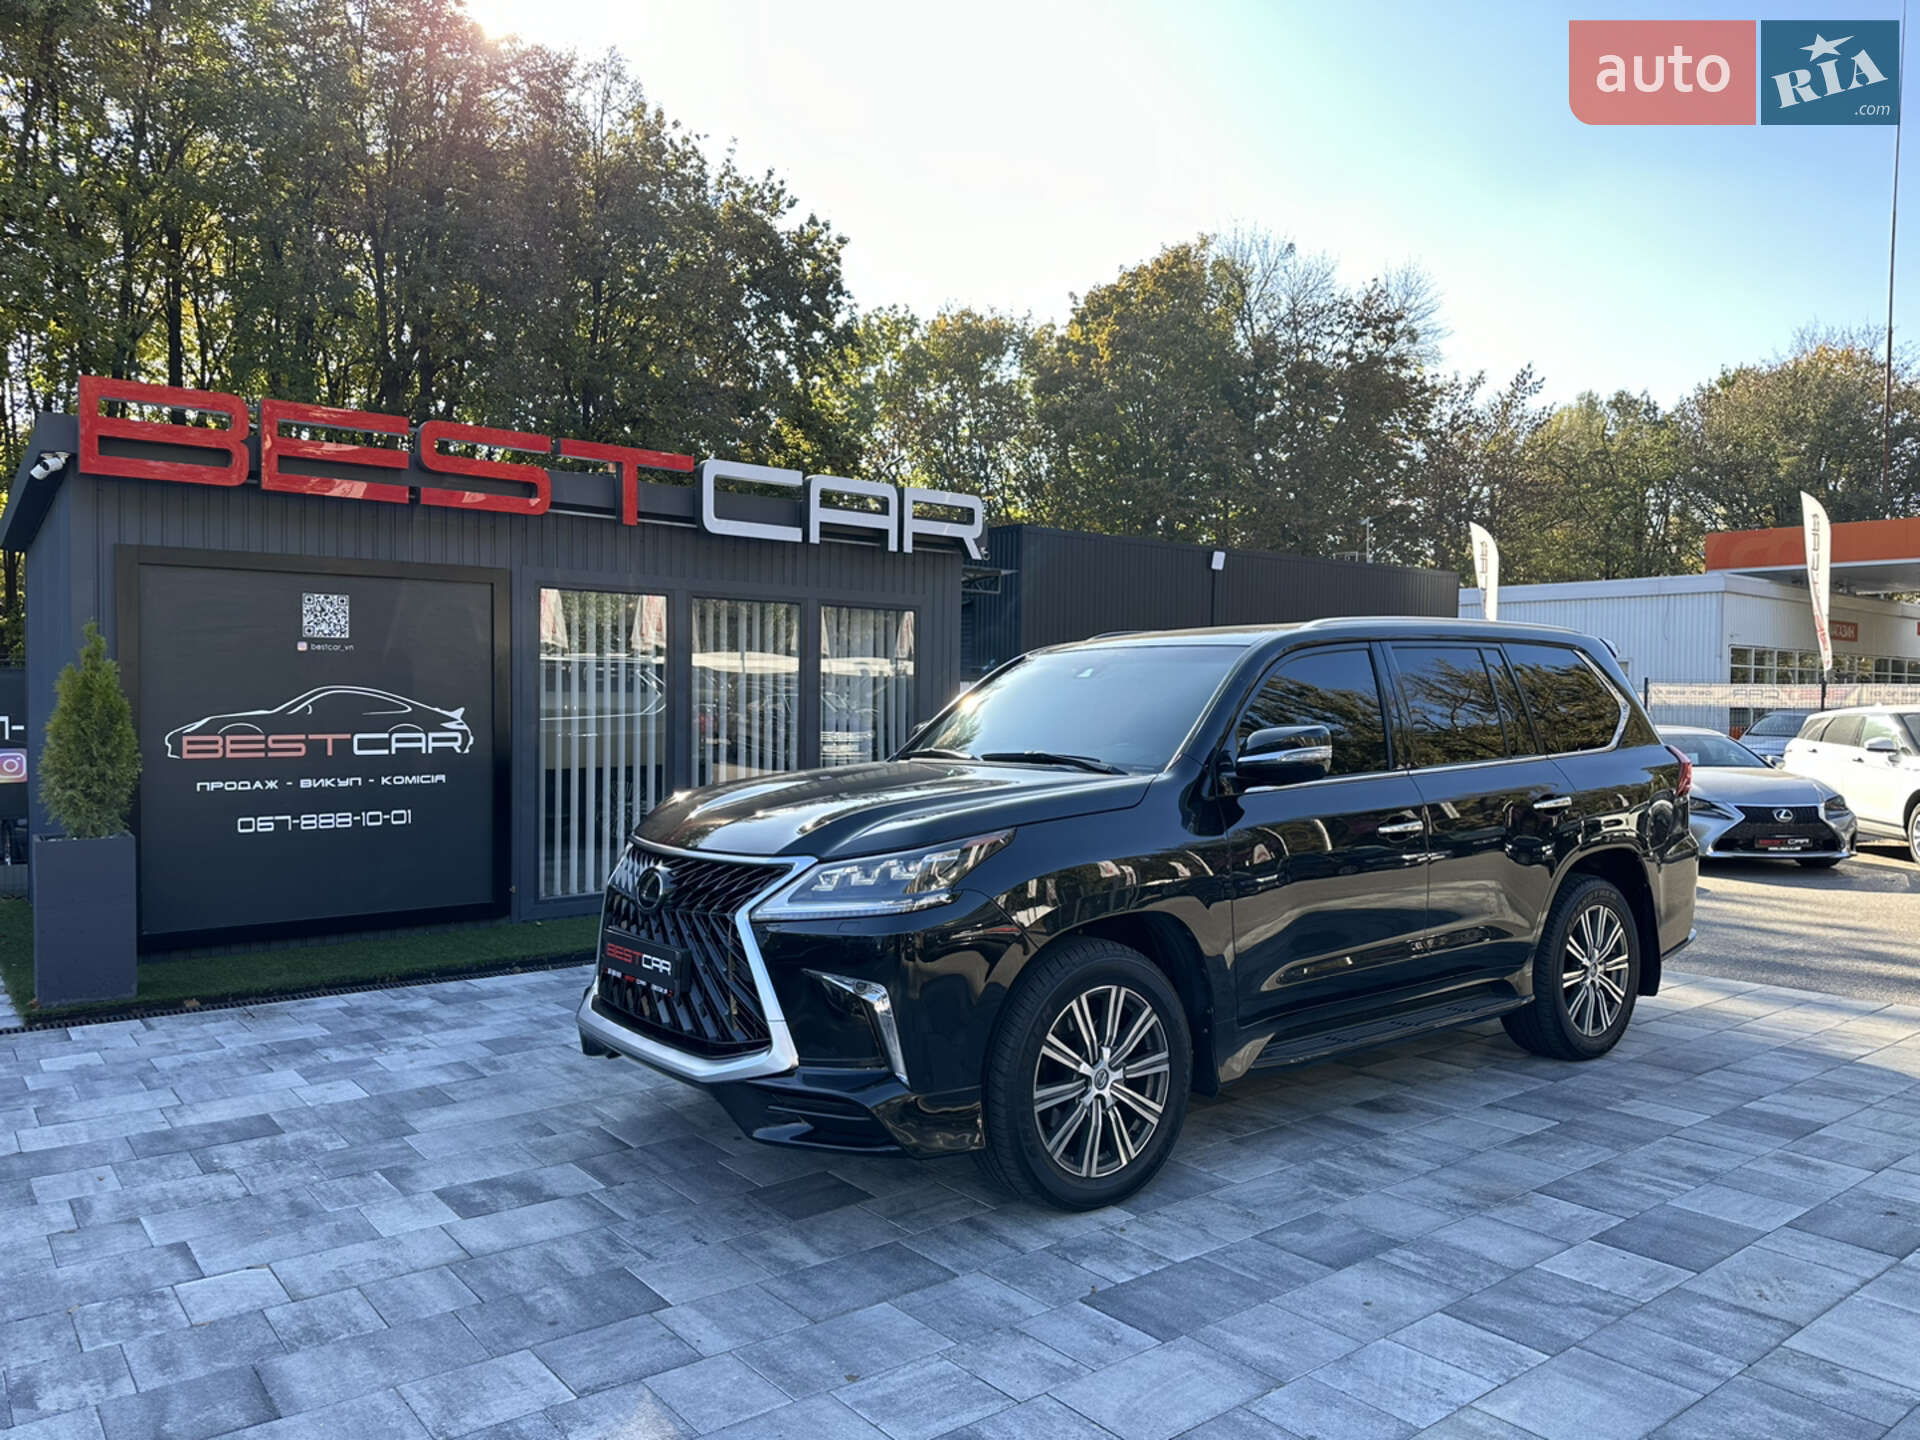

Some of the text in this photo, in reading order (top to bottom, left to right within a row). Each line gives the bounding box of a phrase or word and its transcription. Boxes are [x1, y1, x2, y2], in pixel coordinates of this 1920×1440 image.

[196, 780, 279, 792] ПРОДАЖ
[299, 777, 362, 788] ВИКУП
[381, 774, 446, 786] КОМІСІЯ
[237, 809, 412, 834] 067-888-10-01
